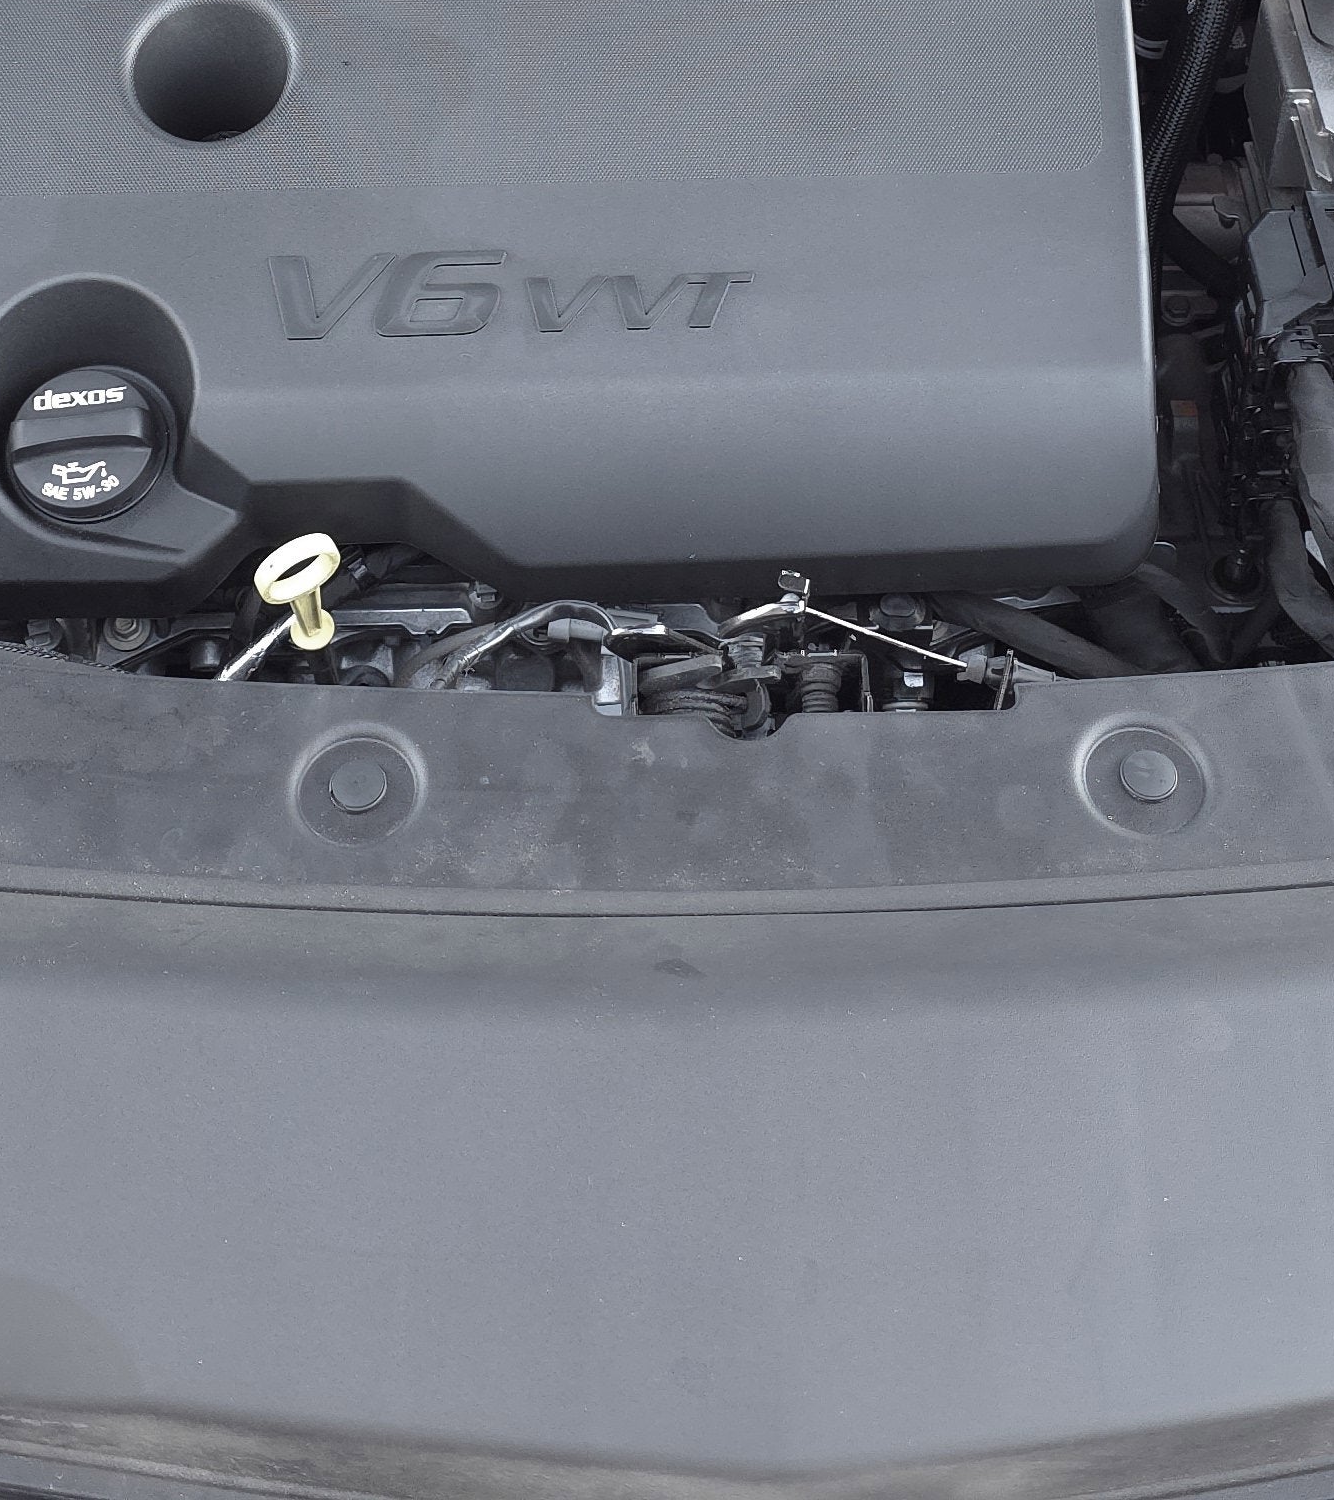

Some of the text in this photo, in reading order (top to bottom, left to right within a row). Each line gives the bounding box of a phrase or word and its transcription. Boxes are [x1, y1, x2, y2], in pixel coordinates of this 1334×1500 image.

[267, 250, 756, 341] V6 VVT
[33, 386, 127, 411] dexos
[41, 474, 120, 501] SAE 5W-30
